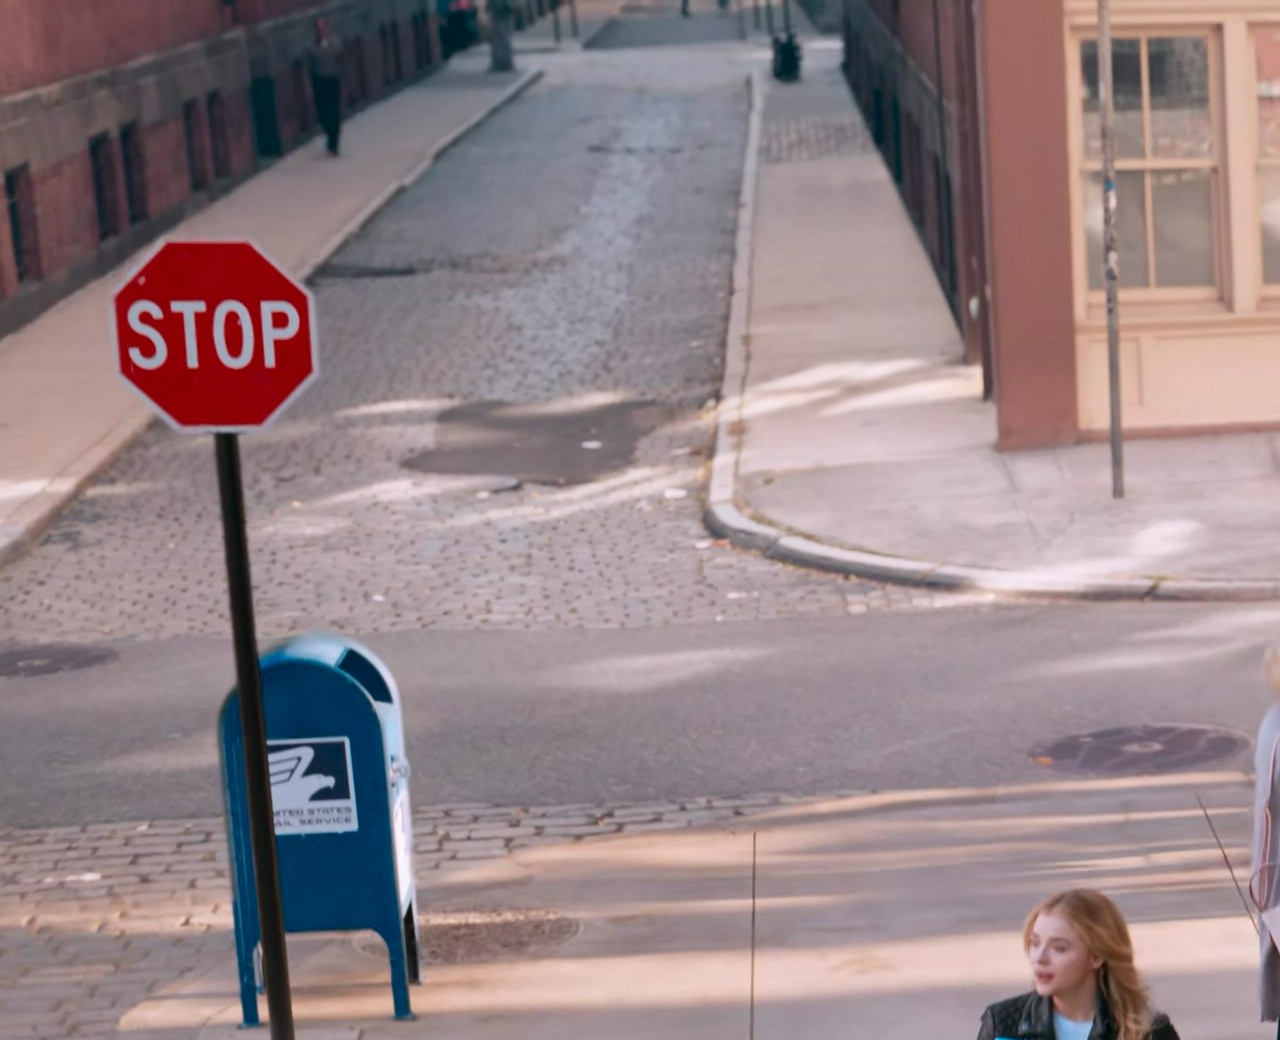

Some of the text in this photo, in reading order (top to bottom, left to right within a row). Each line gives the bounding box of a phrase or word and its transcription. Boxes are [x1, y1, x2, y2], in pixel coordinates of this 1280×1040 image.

[127, 299, 300, 370] STOP
[307, 806, 352, 816] STATES
[275, 817, 352, 827] AIL SERVICE
